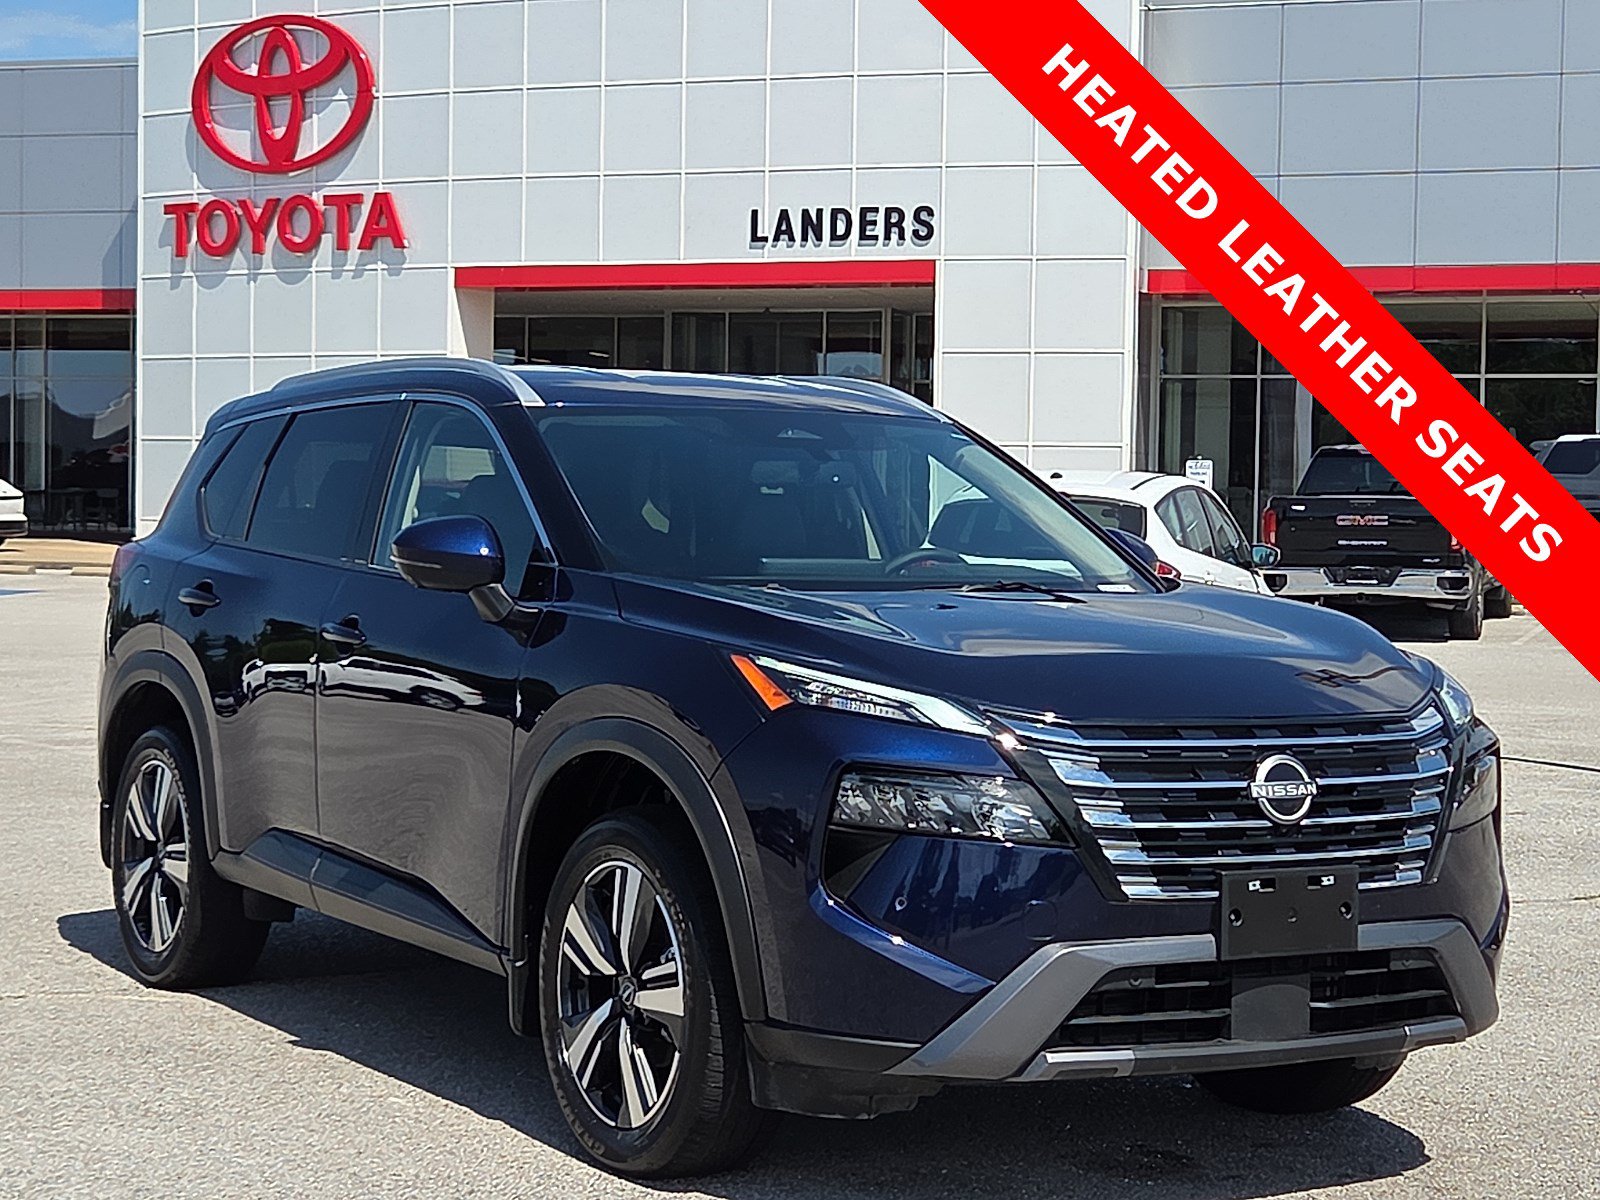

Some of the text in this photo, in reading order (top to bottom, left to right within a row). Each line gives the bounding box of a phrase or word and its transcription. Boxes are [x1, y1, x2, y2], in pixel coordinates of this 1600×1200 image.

[163, 191, 408, 258] TOYOTA
[750, 205, 935, 248] LANDERS
[1251, 782, 1318, 798] NISSAN
